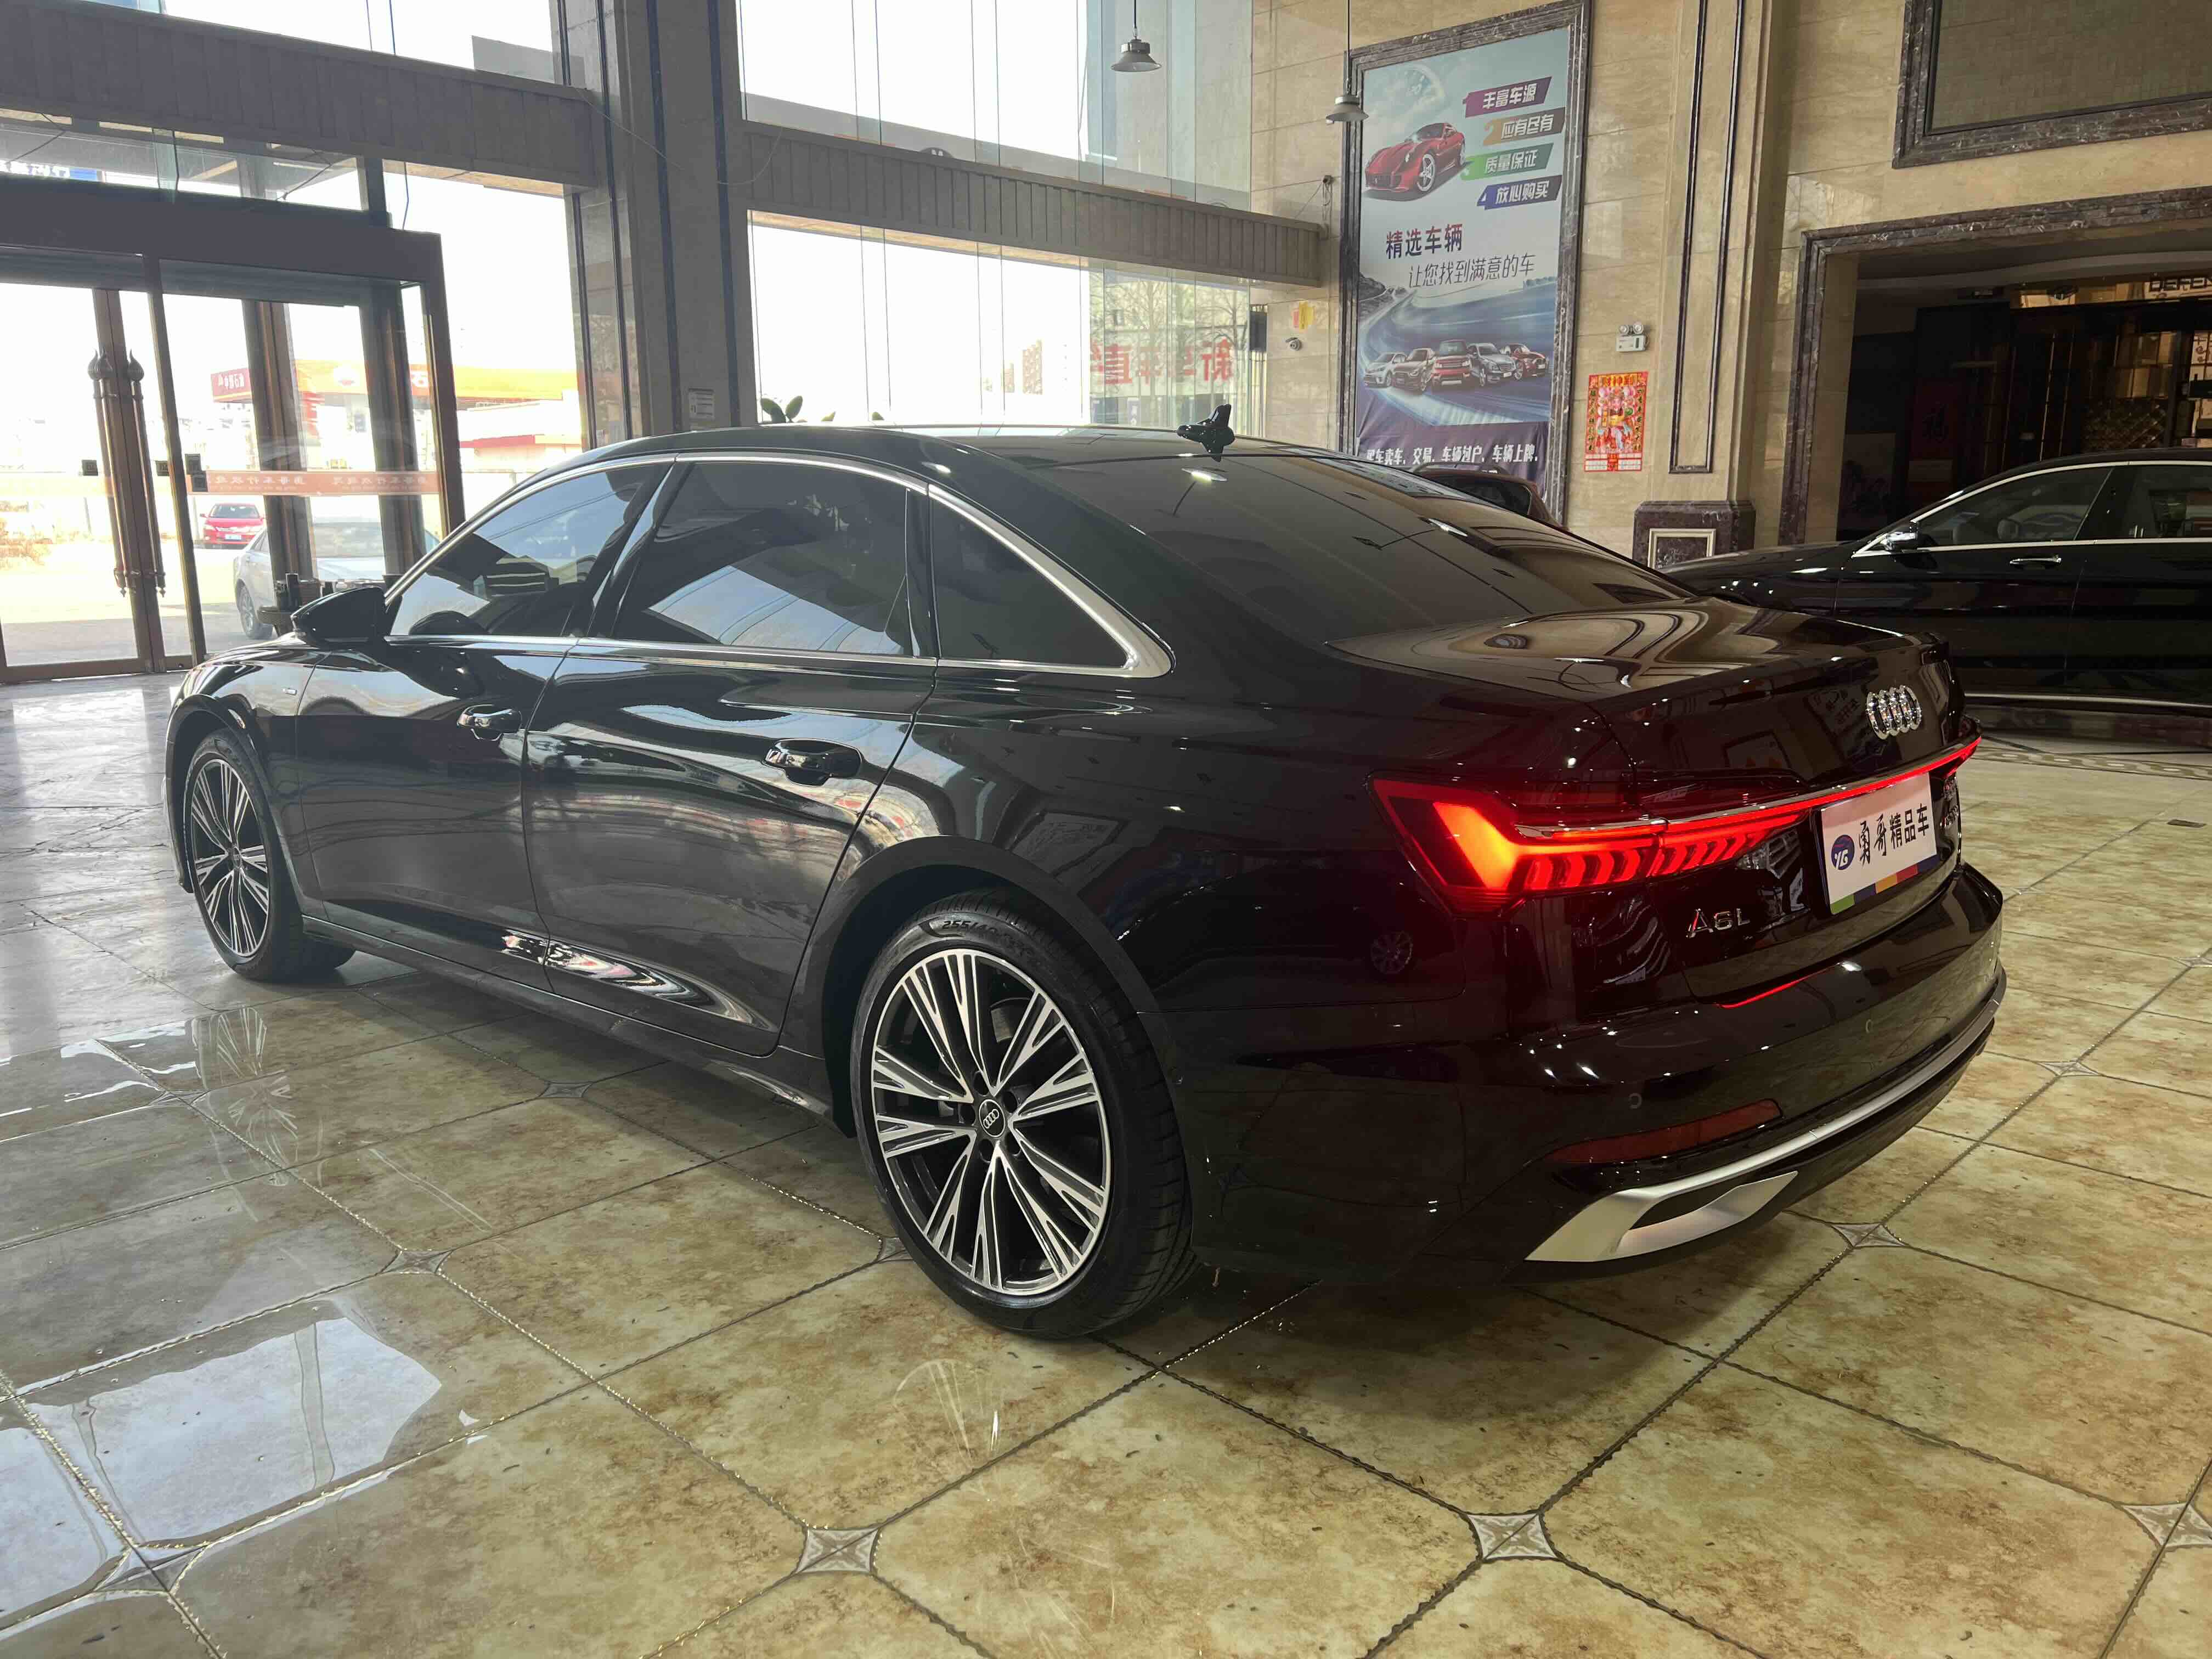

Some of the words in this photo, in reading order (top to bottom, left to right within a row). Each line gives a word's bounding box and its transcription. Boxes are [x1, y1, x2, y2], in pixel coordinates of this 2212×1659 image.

[1482, 83, 1537, 109] 丰富车源
[1501, 114, 1554, 139] 应有尽有
[1485, 149, 1538, 174] 质量保证
[1496, 180, 1550, 205] 放心购买
[1386, 223, 1463, 259] 精选车辆
[1409, 252, 1536, 289] 让您找到满意的车
